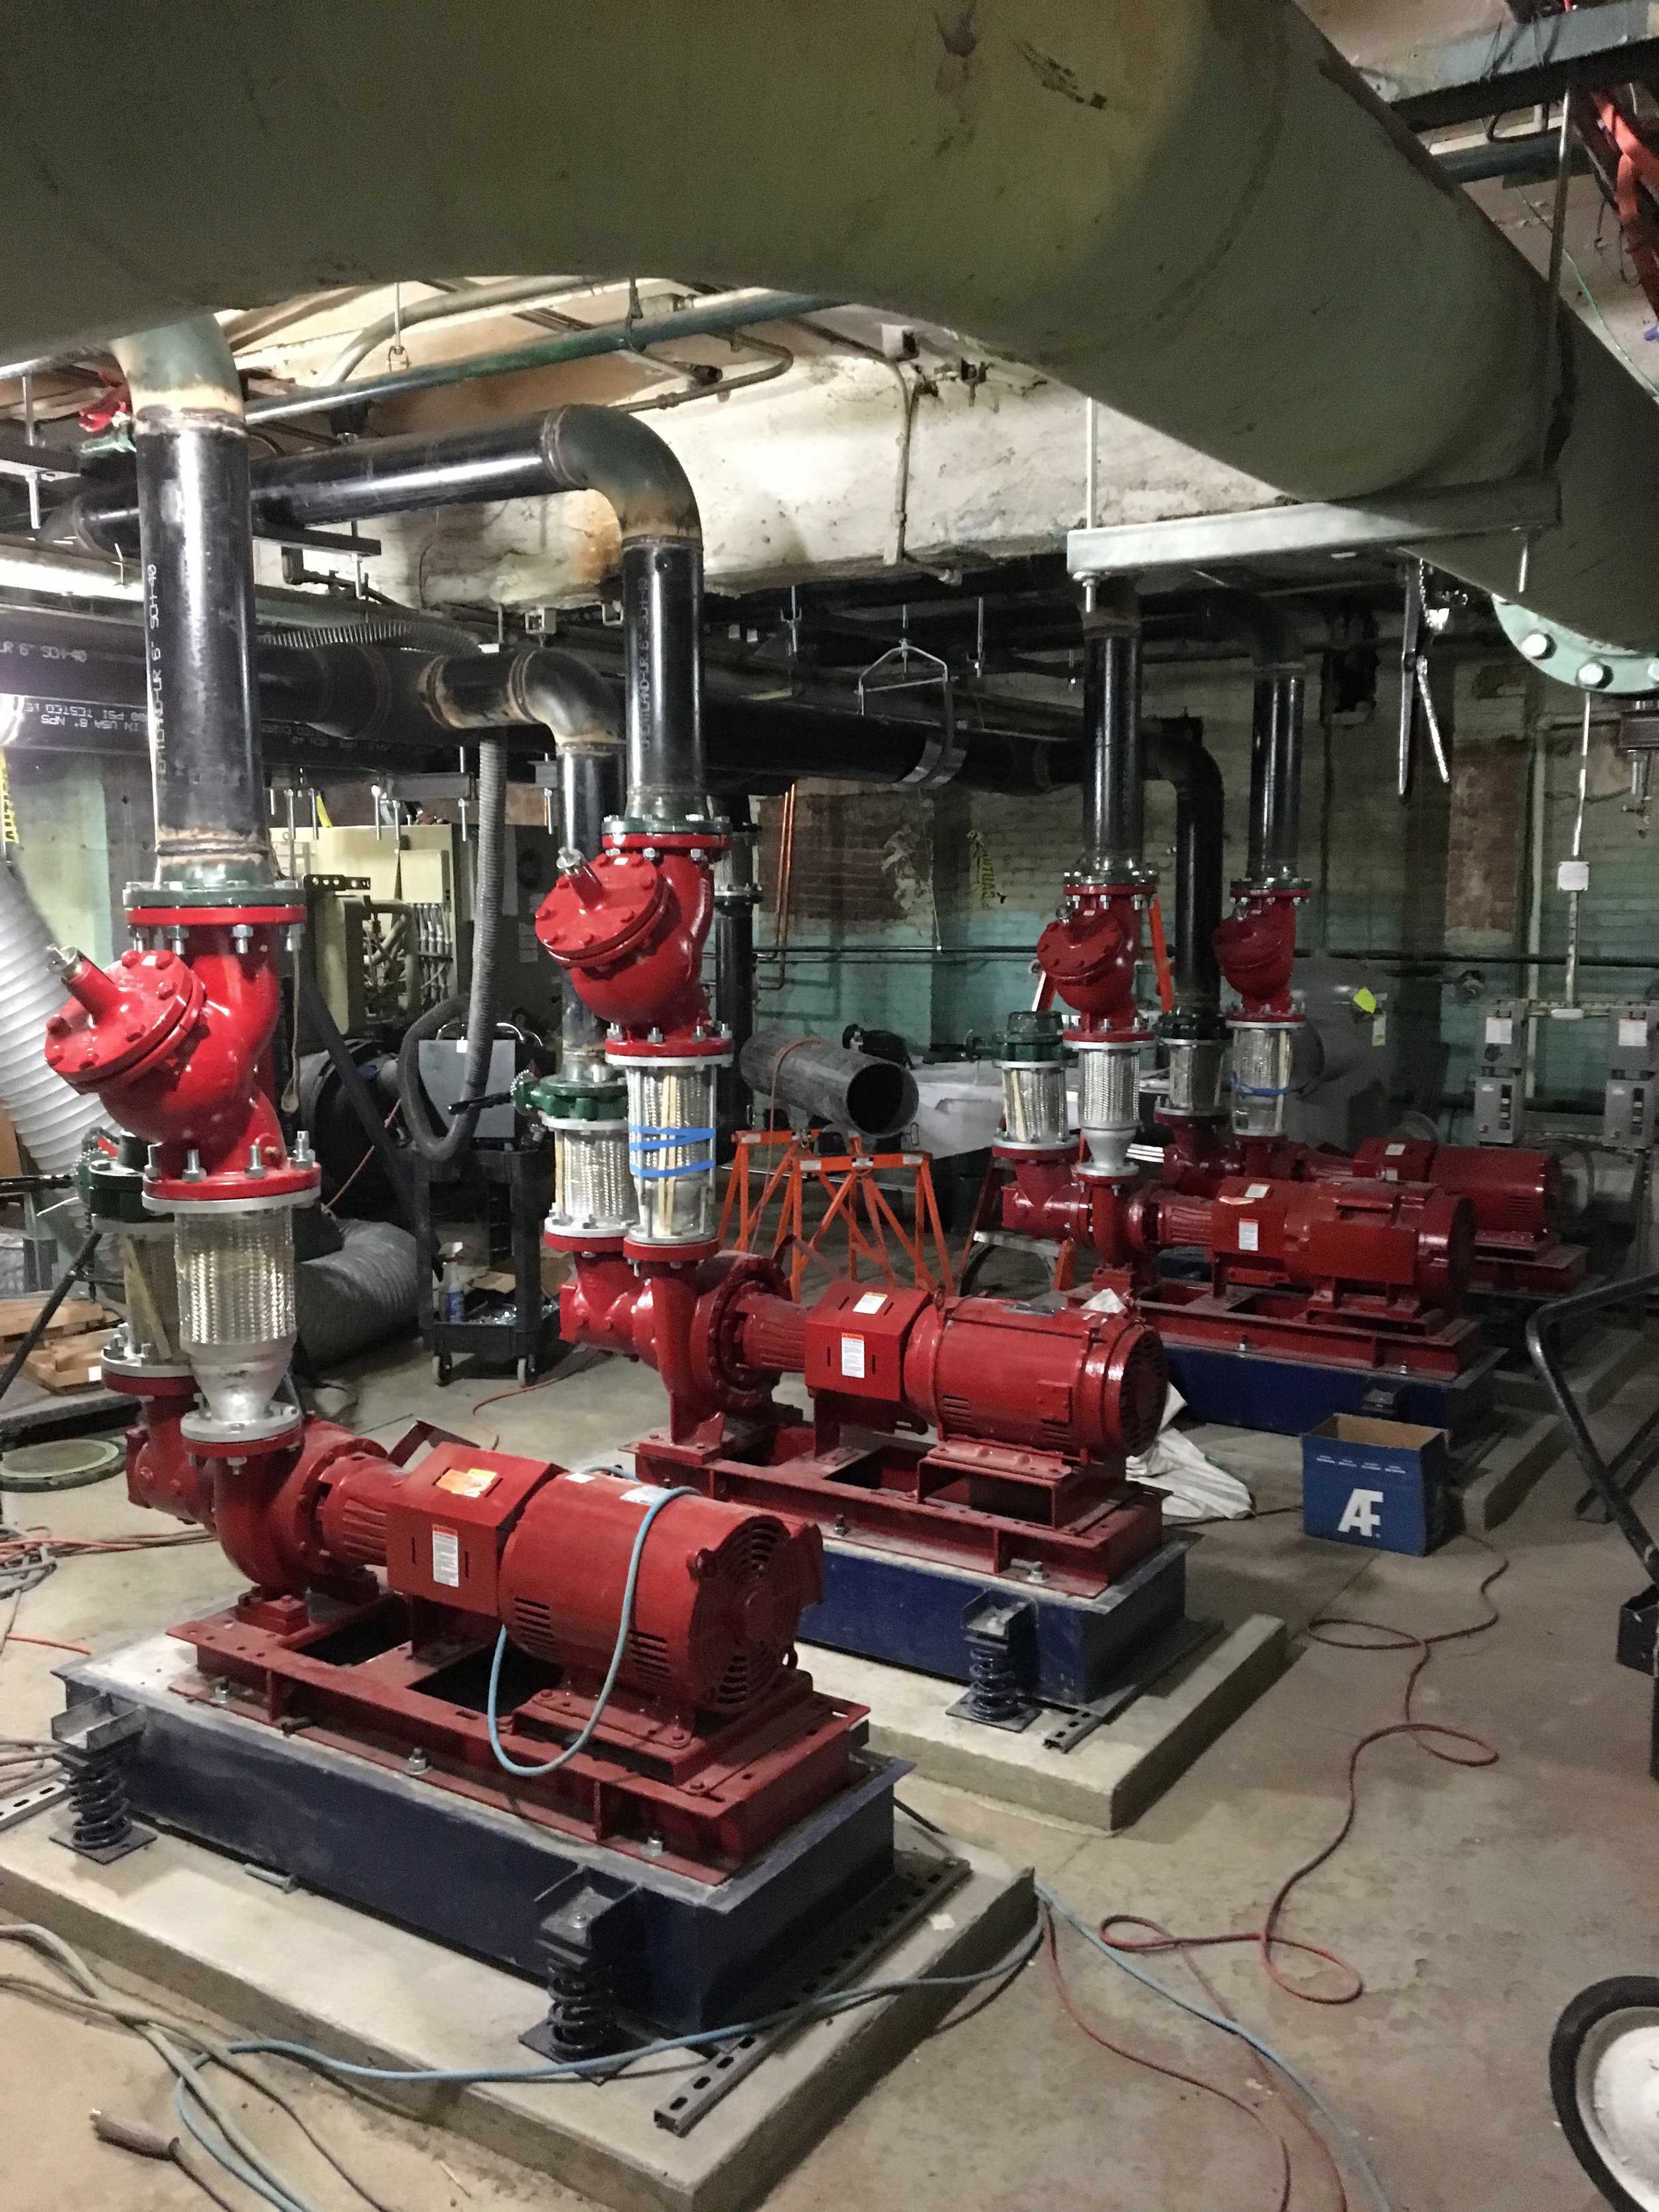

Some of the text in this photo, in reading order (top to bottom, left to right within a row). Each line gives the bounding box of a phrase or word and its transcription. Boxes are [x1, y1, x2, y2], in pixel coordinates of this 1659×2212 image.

[45, 704, 93, 717] TESTED
[103, 709, 124, 721] PSI
[41, 714, 65, 725] NPS
[94, 720, 118, 729] USA
